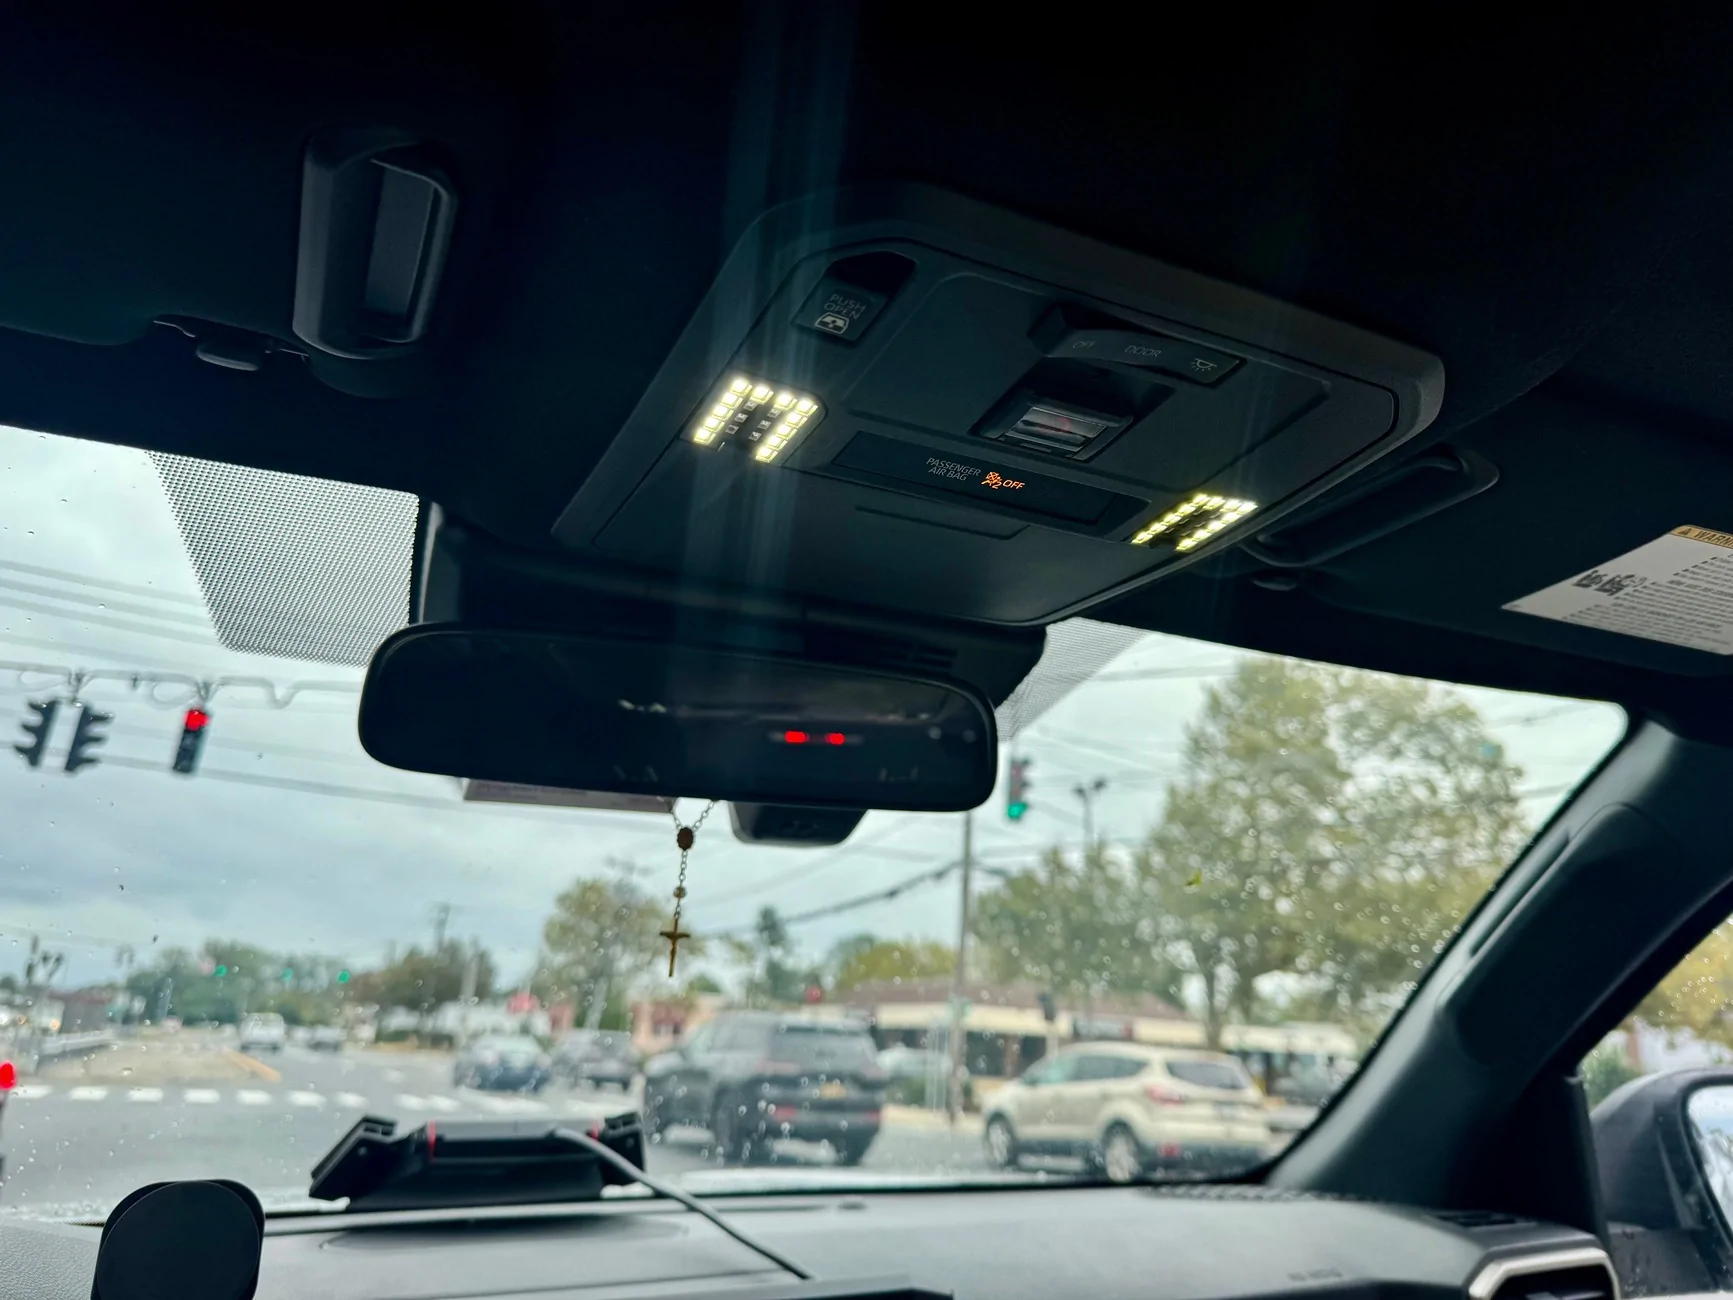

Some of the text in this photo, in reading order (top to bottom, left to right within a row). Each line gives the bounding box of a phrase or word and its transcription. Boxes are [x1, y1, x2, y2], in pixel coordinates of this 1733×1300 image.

[823, 302, 862, 320] OPEN
[829, 293, 867, 313] PUSH
[1124, 344, 1162, 358] DOOR
[926, 457, 982, 477] PASSENGER
[928, 466, 969, 481] AIR BAG
[1002, 479, 1026, 490] OFF
